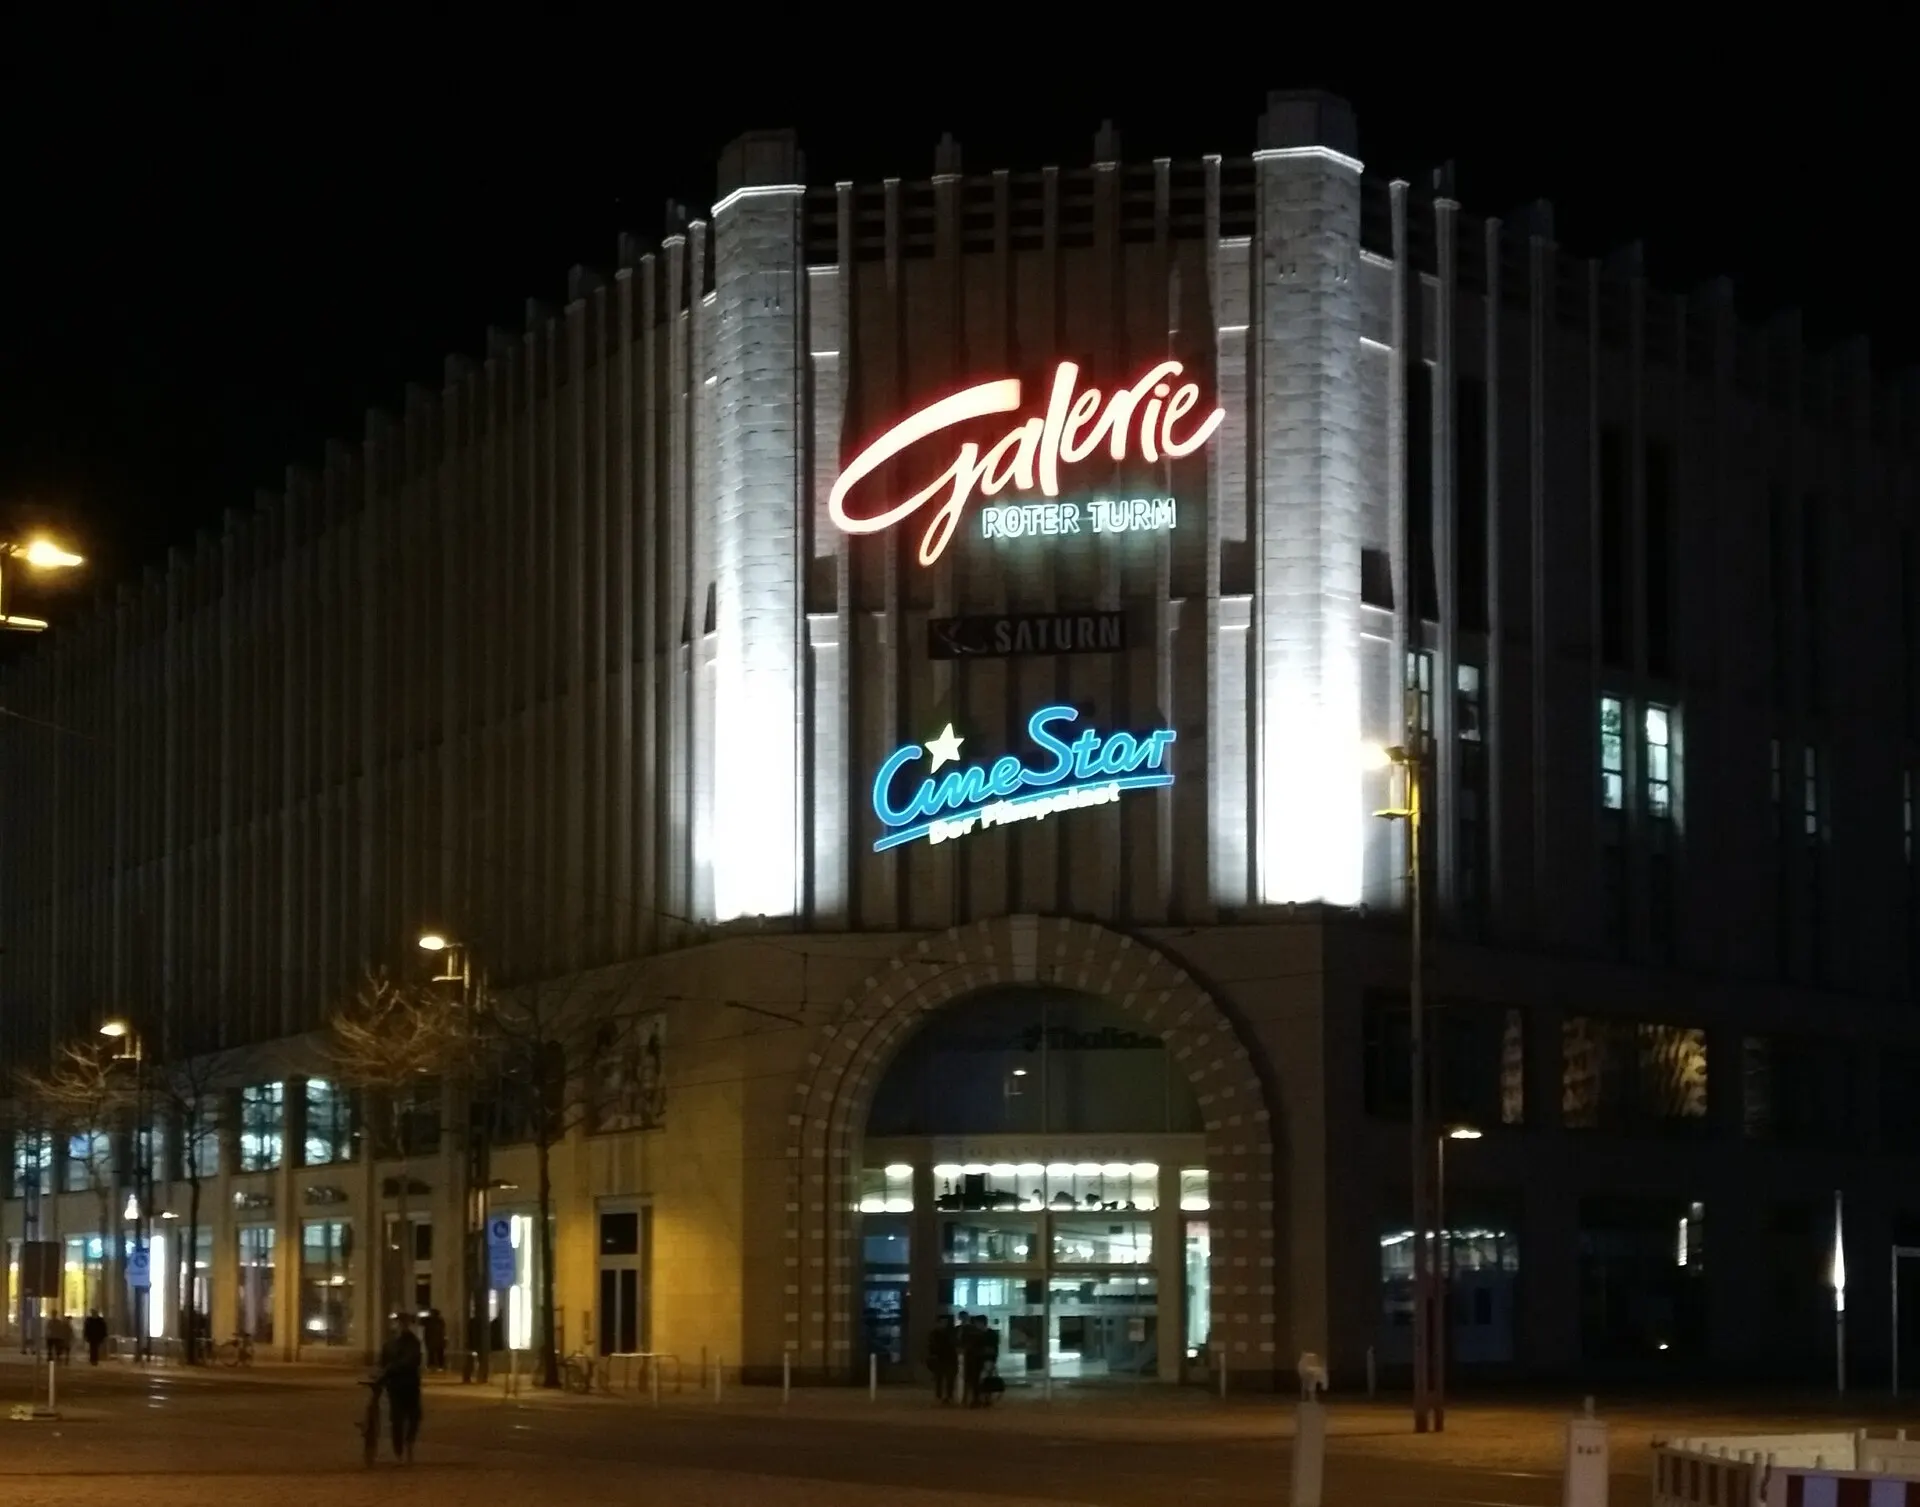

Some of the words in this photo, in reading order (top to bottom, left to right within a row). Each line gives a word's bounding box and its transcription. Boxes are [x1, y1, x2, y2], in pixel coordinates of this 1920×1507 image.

[829, 360, 1226, 567] Galerie
[982, 503, 1080, 539] ROTER
[1086, 496, 1177, 535] TURM
[994, 615, 1121, 654] SATURN
